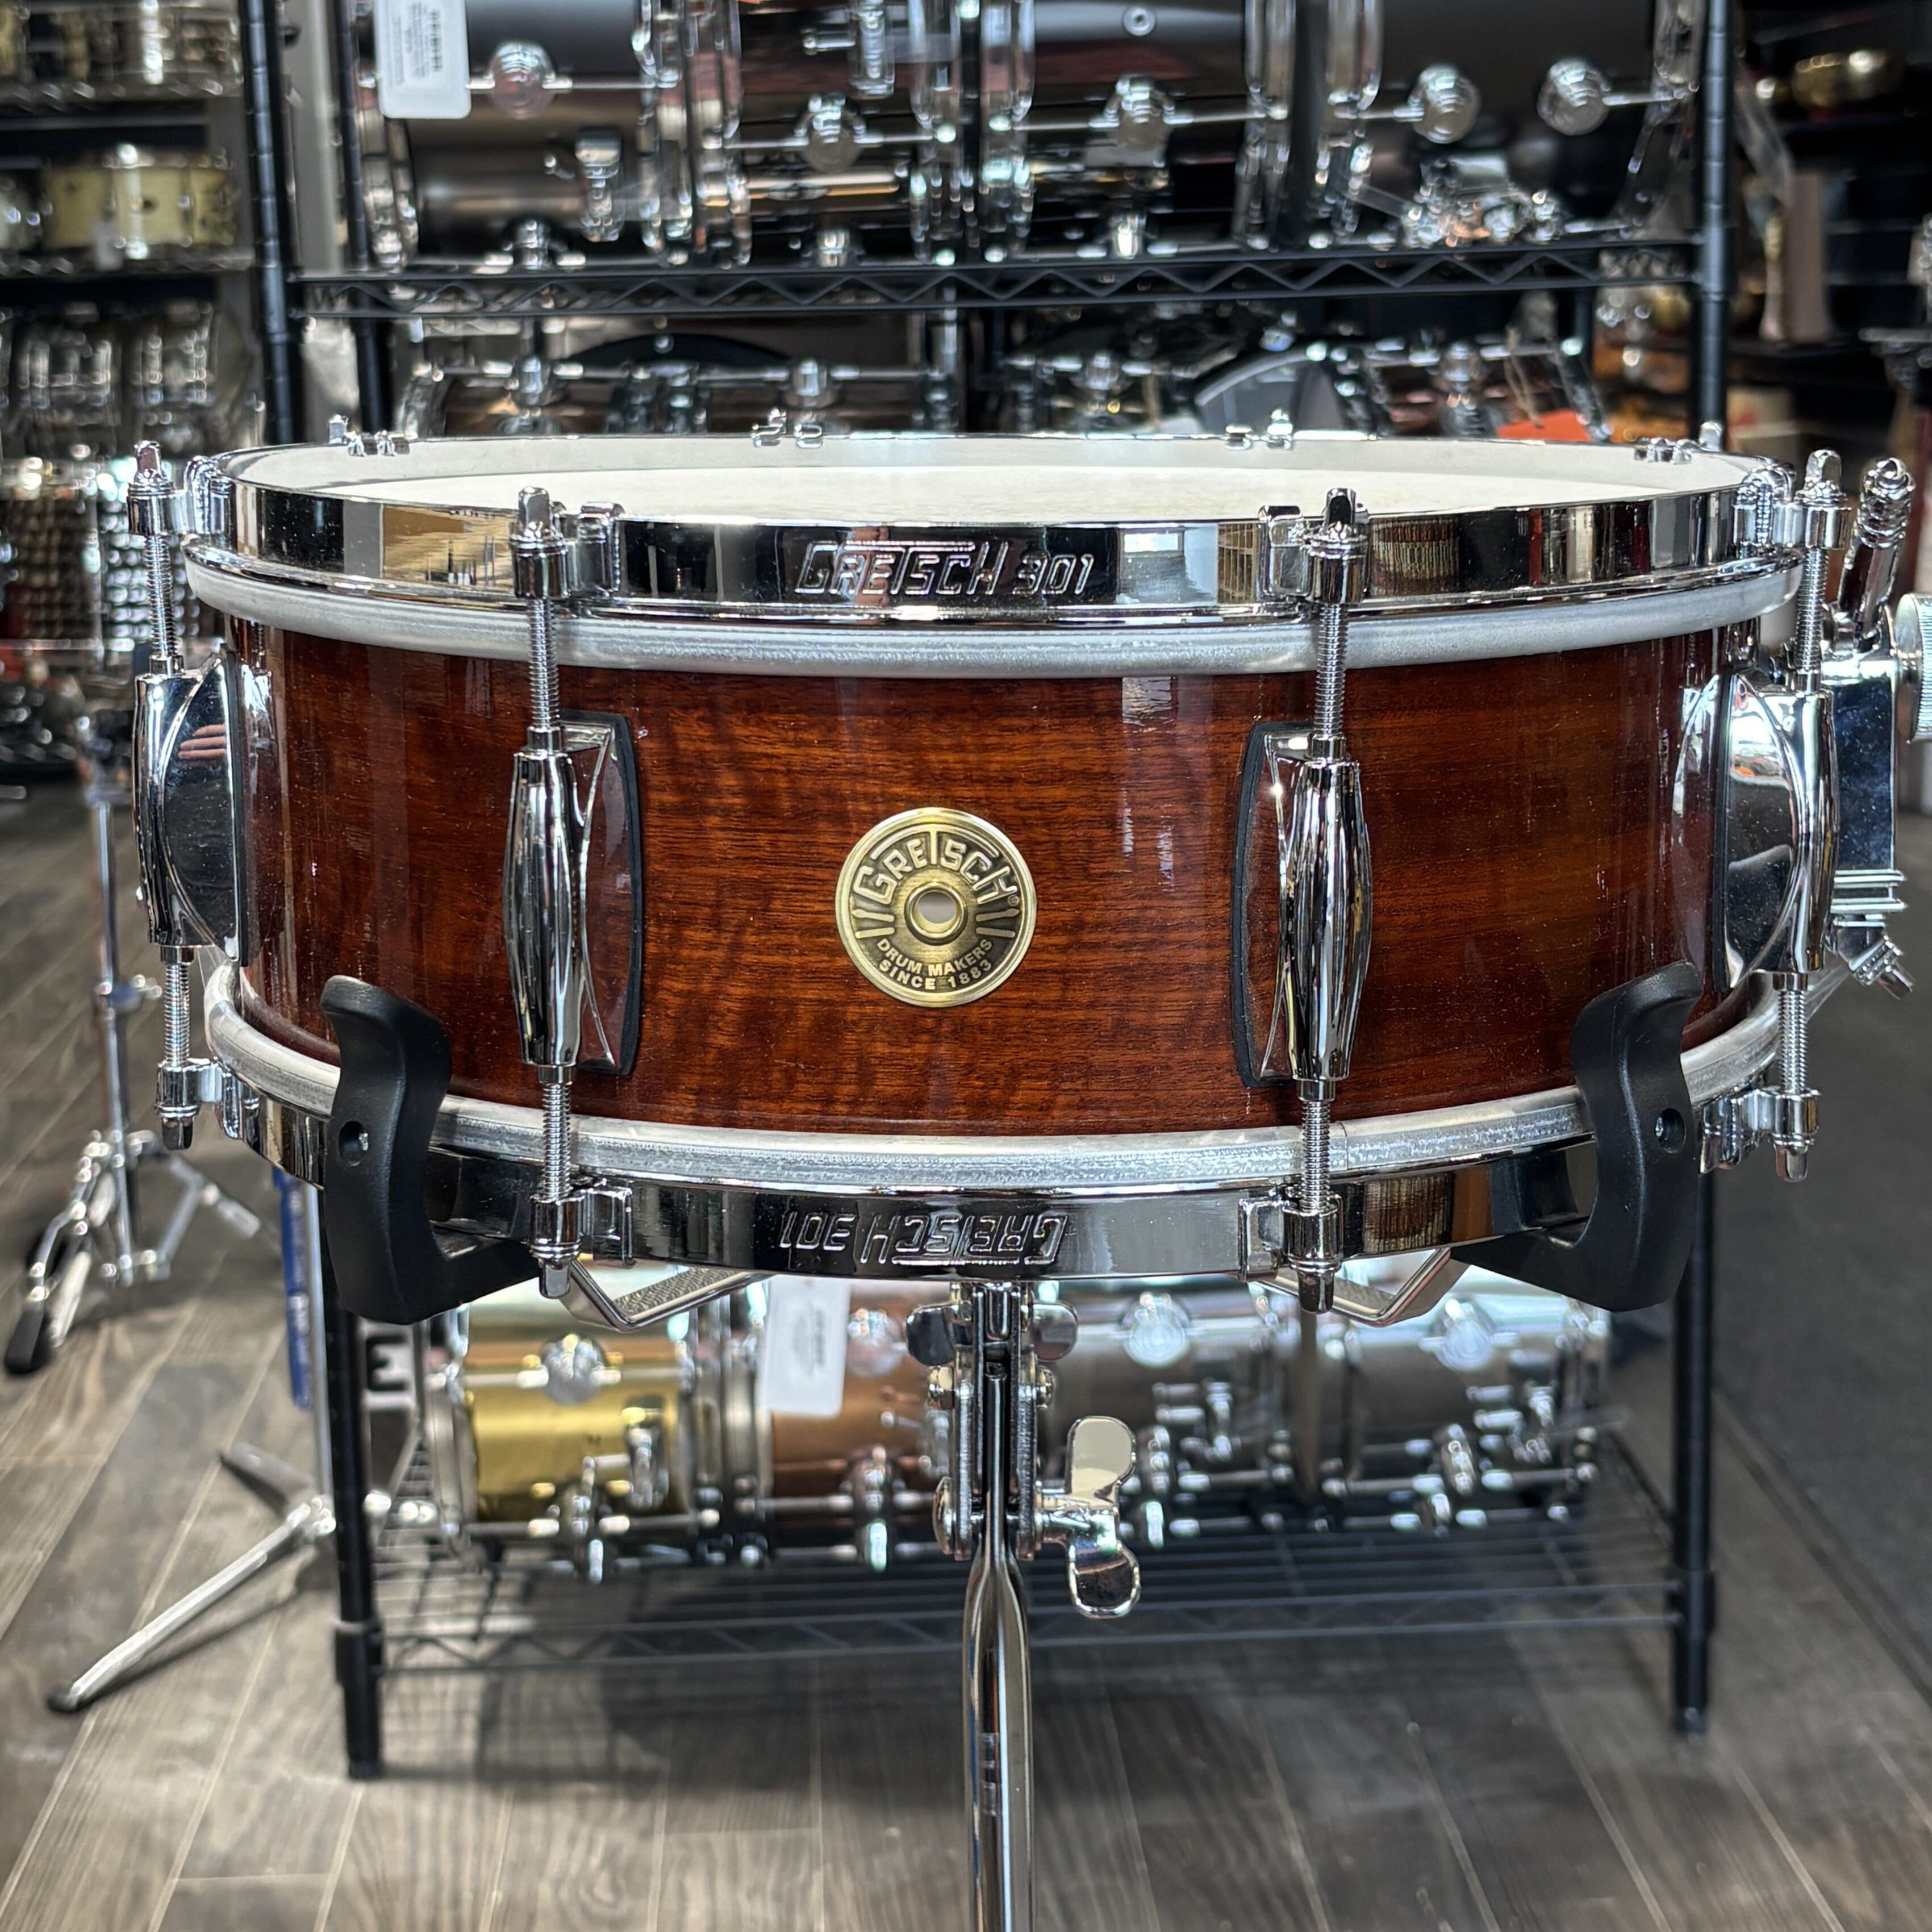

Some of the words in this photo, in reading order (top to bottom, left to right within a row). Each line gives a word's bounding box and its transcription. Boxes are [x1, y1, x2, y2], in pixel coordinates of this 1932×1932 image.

[794, 540, 1009, 595] GRETSCH
[1012, 553, 1094, 595] 301
[852, 823, 1018, 905] GRETSCH
[877, 938, 921, 975] DRUM
[928, 938, 992, 977] MAKERS
[879, 959, 937, 990] SINCE
[948, 958, 992, 988] 1883
[779, 1210, 856, 1251] 301
[860, 1210, 1069, 1265] GRETSCH
